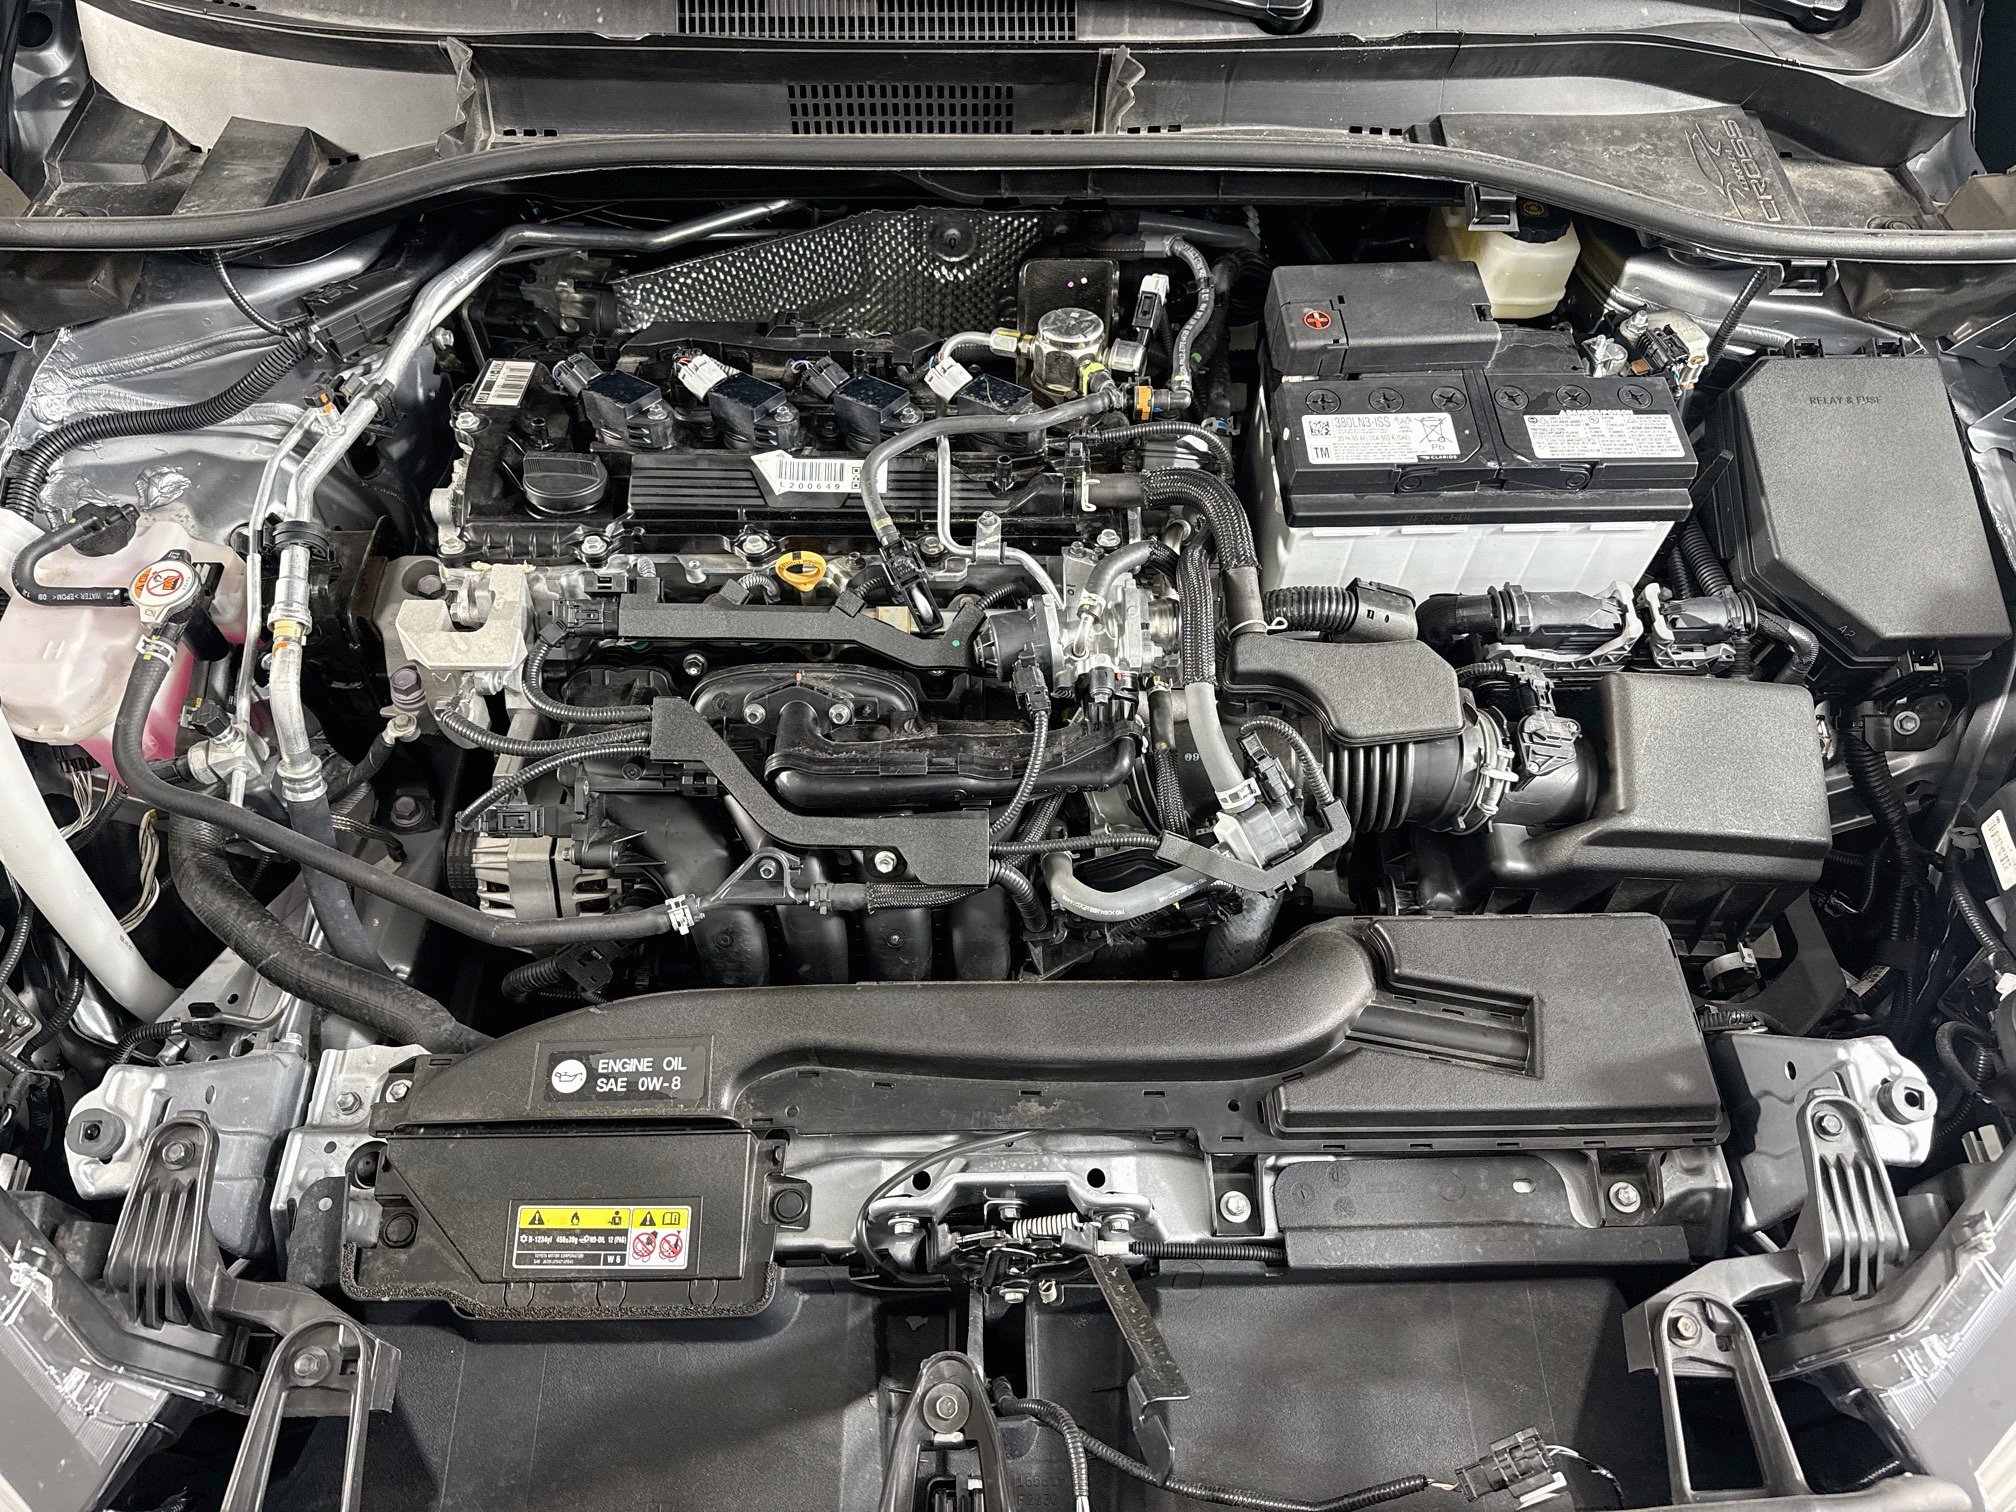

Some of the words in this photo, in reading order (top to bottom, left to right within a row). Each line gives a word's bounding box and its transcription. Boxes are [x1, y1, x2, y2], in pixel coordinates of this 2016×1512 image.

[1721, 119, 1782, 222] CROSS
[1809, 396, 1843, 405] RELAY
[1313, 447, 1331, 459] TM
[80, 592, 102, 600] WATER
[597, 1057, 654, 1073] ENGINE
[662, 1056, 688, 1071] OIL
[596, 1077, 628, 1092] SAE
[638, 1076, 682, 1091] 0W-8
[607, 1255, 616, 1264] W
[615, 1255, 621, 1264] 6
